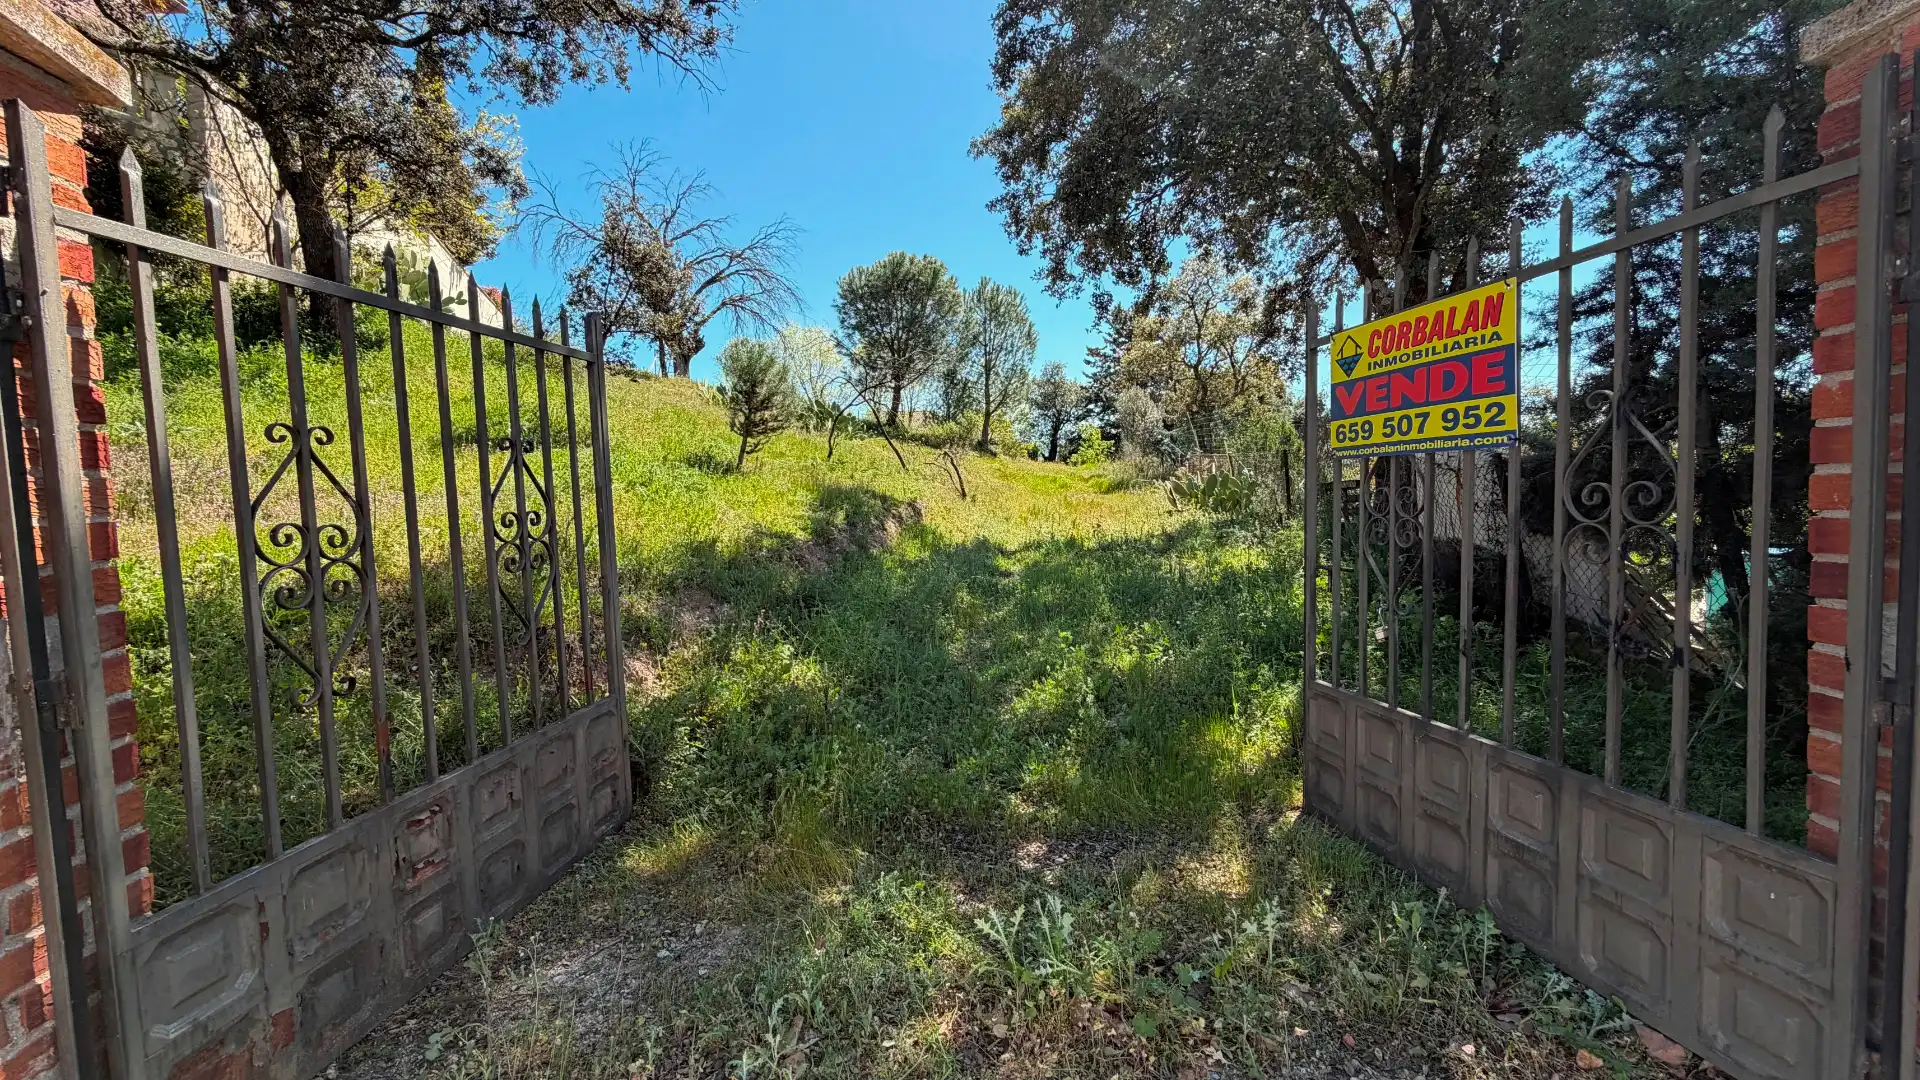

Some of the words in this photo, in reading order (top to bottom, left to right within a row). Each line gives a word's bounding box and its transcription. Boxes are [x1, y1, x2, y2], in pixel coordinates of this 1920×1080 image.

[1368, 292, 1505, 359] CORBALAN
[1368, 331, 1503, 371] INMOBILIARIA
[1335, 350, 1506, 416] VENDE
[1335, 419, 1374, 444] 659
[1381, 411, 1430, 438] 507
[1441, 402, 1506, 432] 952
[1336, 434, 1508, 457] www.corbalaninmobiliaria.com
